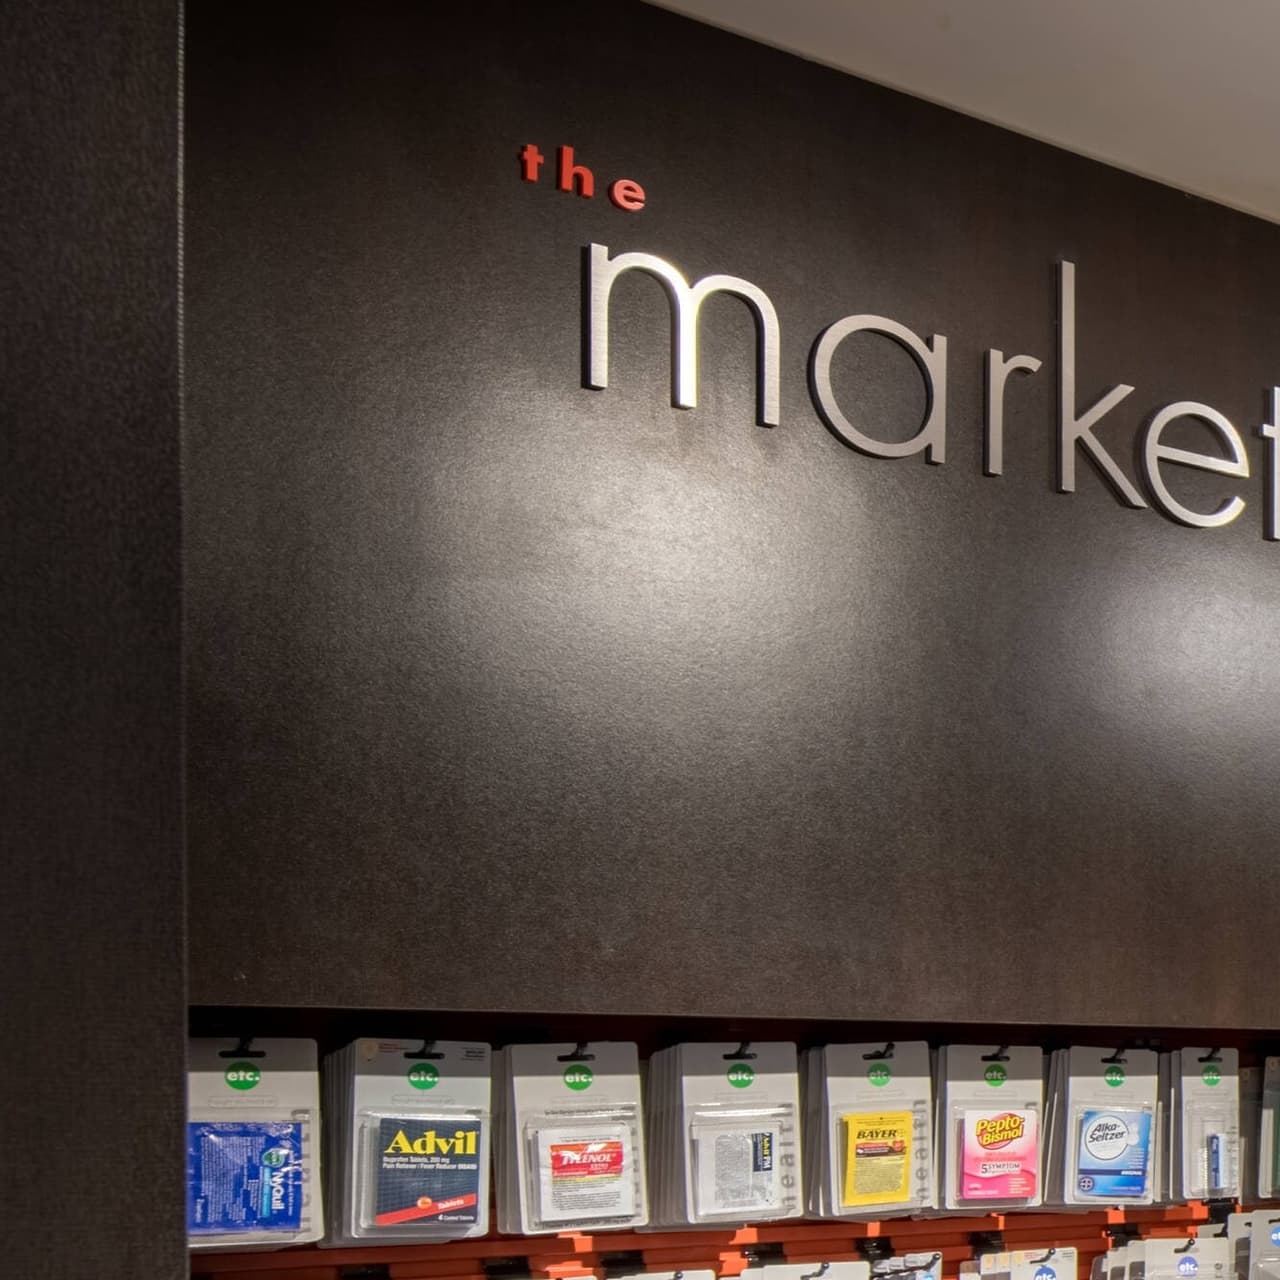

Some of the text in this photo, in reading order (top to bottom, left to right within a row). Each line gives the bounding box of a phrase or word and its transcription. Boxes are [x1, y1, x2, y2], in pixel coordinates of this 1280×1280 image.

[519, 144, 647, 211] the
[226, 1070, 260, 1081] etc.
[408, 1071, 438, 1082] etc.
[564, 1072, 593, 1083] etc.
[728, 1072, 753, 1080] etc.
[1106, 1072, 1126, 1081] etc.
[976, 1116, 1025, 1135] Pepto-
[1094, 1124, 1120, 1132] Alka-
[856, 1130, 897, 1139] BAYER
[982, 1126, 1023, 1146] Bismol
[1089, 1129, 1126, 1143] Seltzer
[384, 1130, 476, 1154] Advil
[981, 1164, 988, 1174] 5
[270, 1172, 285, 1210] NyQuil
[1180, 1263, 1198, 1272] etc.
